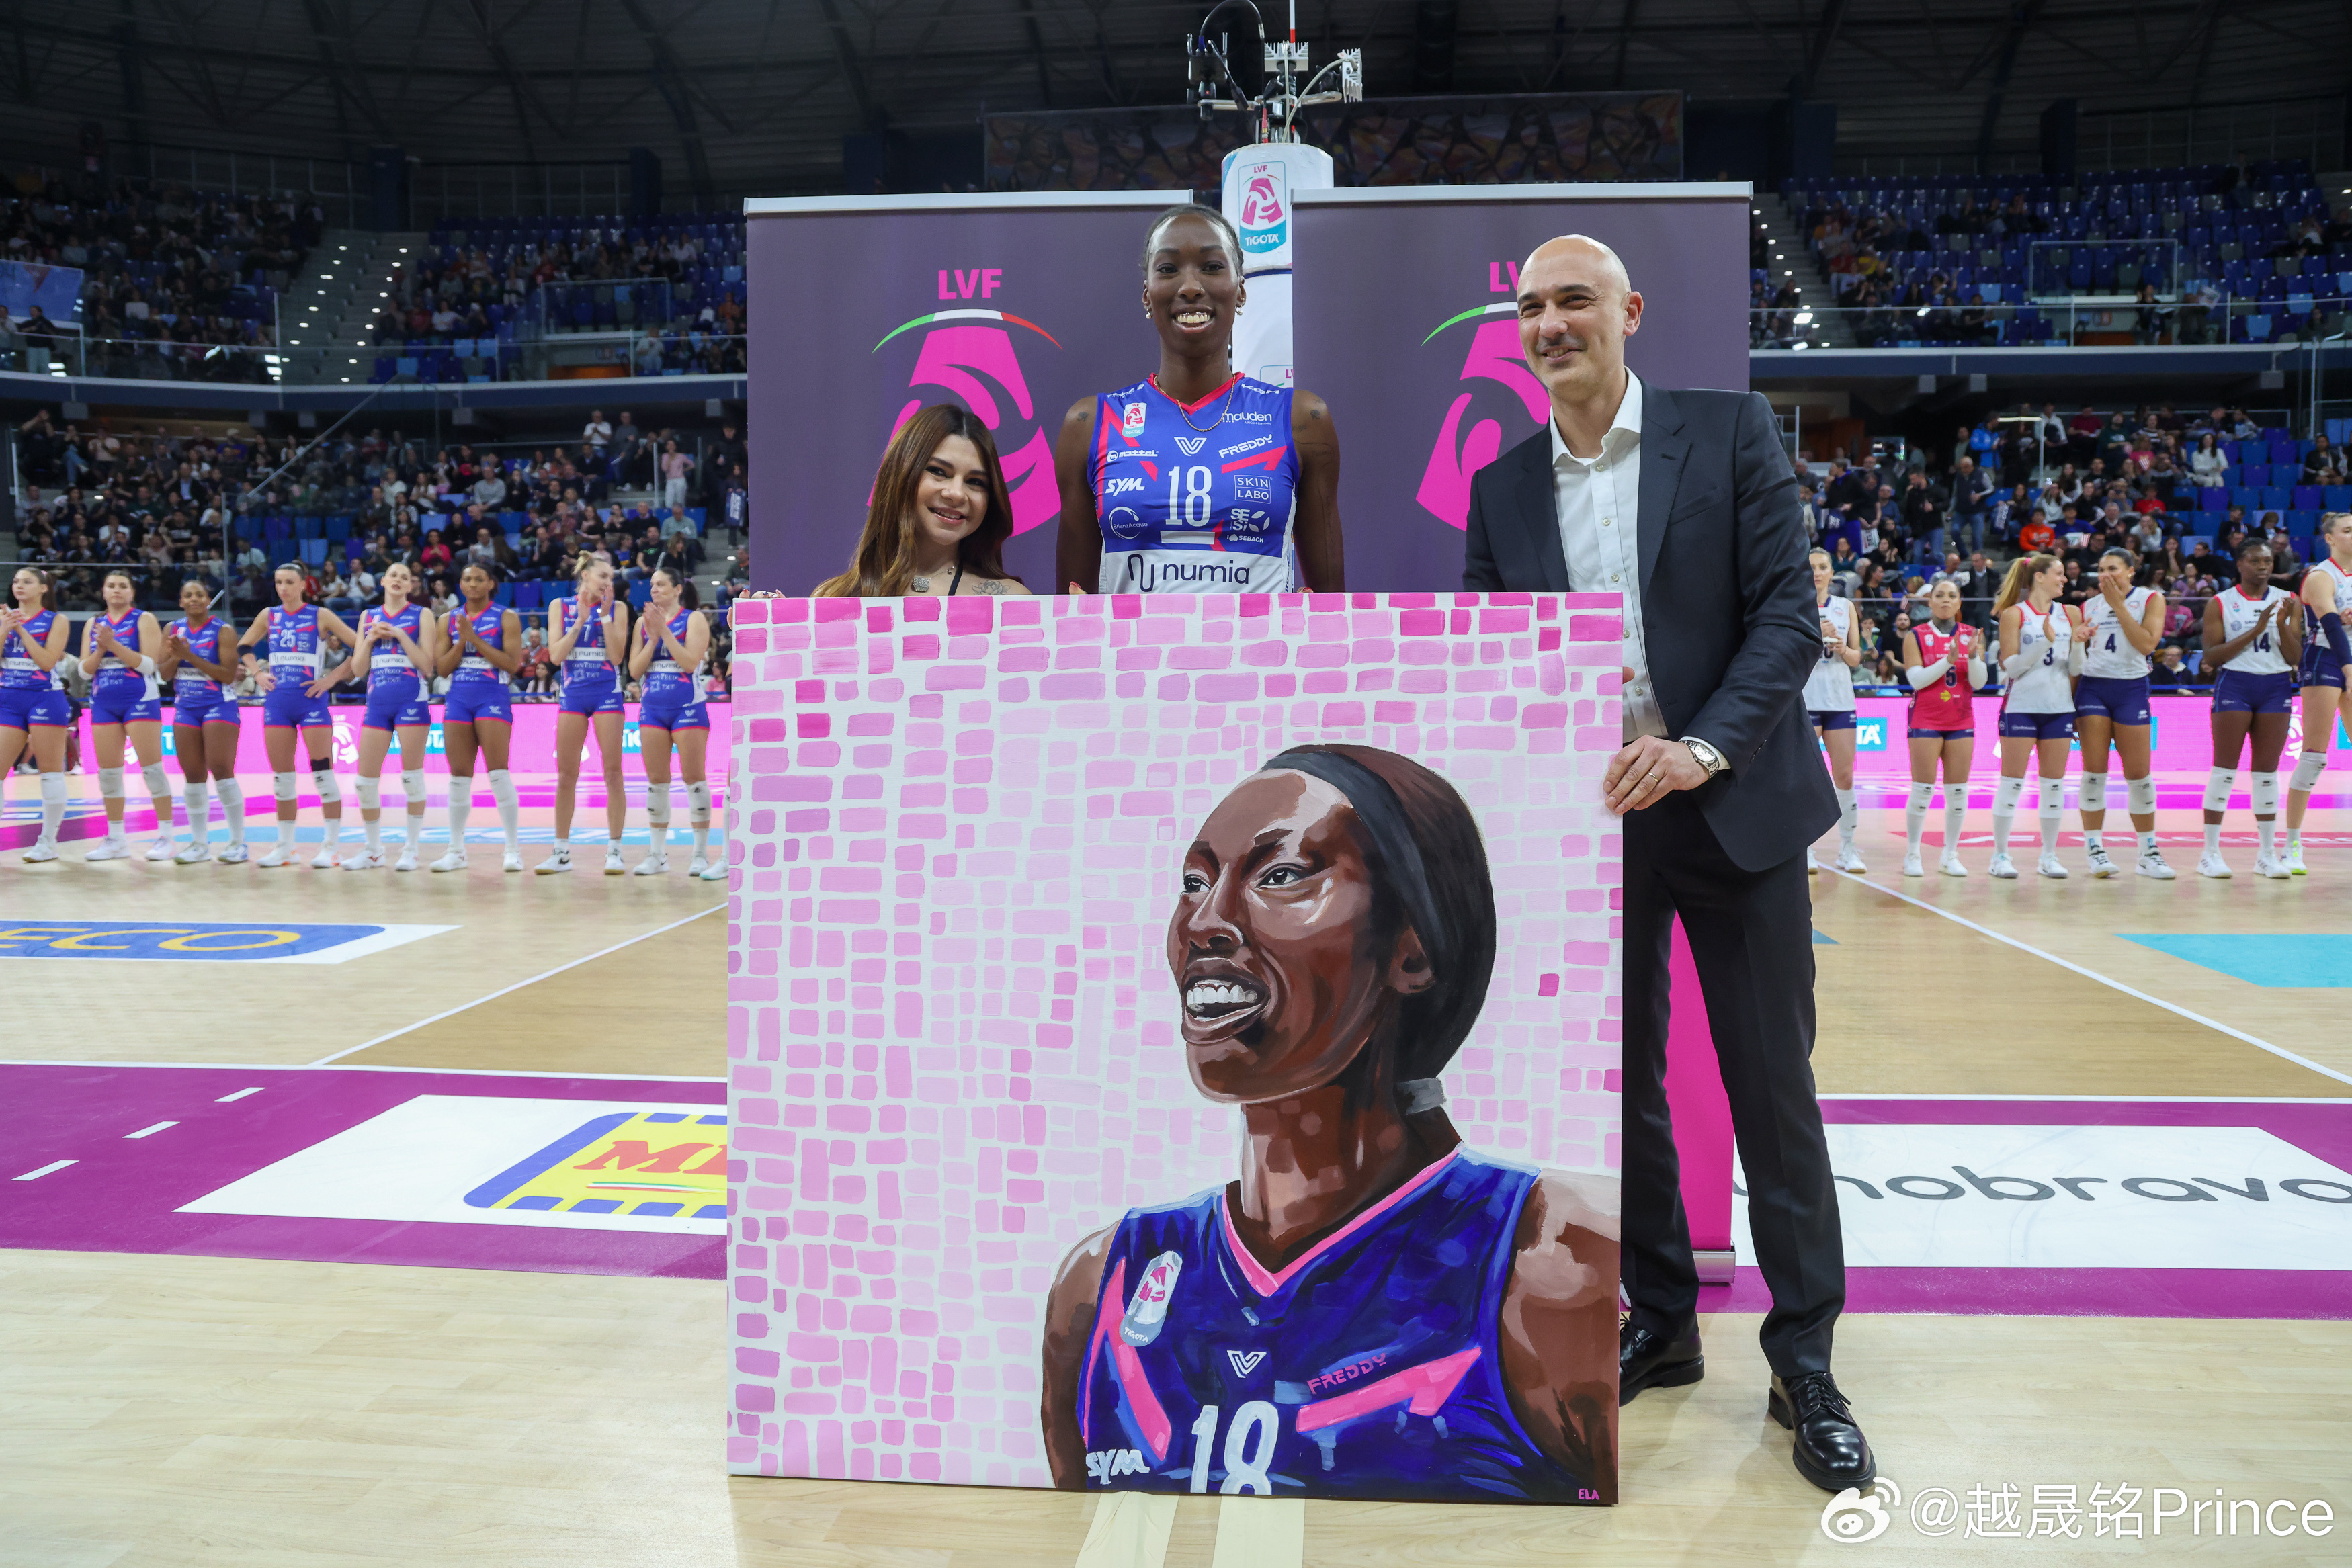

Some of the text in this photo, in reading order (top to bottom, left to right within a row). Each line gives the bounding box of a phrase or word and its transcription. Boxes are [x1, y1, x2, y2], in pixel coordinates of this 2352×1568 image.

[1254, 165, 1267, 173] LVF
[938, 269, 1002, 300] LVF
[1222, 411, 1272, 423] mauden
[1218, 434, 1273, 458] FREDDY
[1105, 478, 1145, 496] SYM
[1237, 476, 1269, 488] SKIN
[1165, 466, 1212, 527] 18
[1237, 490, 1269, 500] LABO
[1163, 560, 1250, 584] numia
[280, 629, 296, 648] 25
[583, 624, 591, 642] 7
[2253, 632, 2271, 653] 14
[2105, 633, 2117, 653] 4
[2043, 647, 2053, 666] 3
[1945, 665, 1957, 688] 5
[1124, 1327, 1148, 1343] TIGOTA
[1306, 1352, 1386, 1395] FREDDY
[1190, 1400, 1279, 1495] 18
[1085, 1448, 1150, 1485] SYM
[1579, 1488, 1599, 1500] ELA
